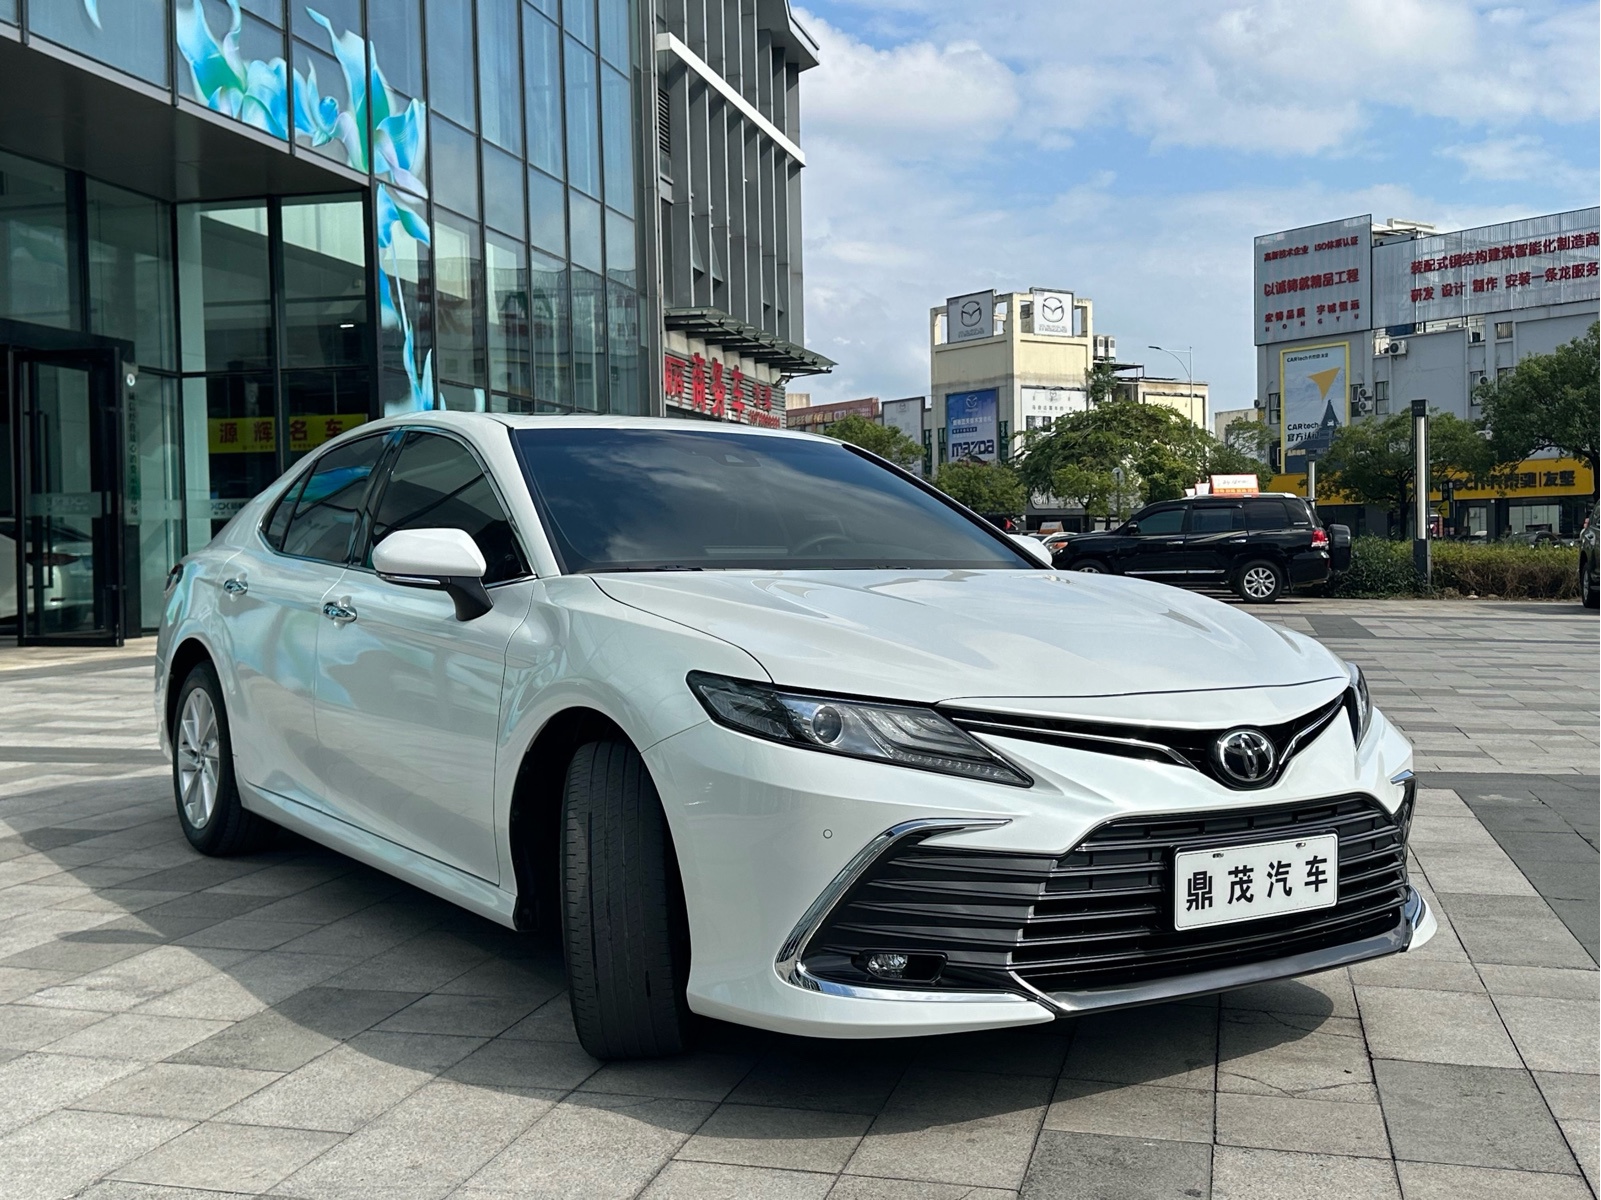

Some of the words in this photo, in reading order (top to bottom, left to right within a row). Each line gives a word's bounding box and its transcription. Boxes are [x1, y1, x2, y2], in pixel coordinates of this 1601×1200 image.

[1410, 231, 1600, 275] 装配式钢结构建筑智能化制造商
[1263, 268, 1360, 297] 以诚铸就精品工程
[1410, 286, 1435, 303] 研发
[1441, 281, 1466, 298] 设计
[1472, 276, 1498, 293] 制作
[1505, 261, 1600, 289] 安装一条龙服务
[219, 418, 343, 444] 源辉名车
[951, 439, 995, 457] mazda
[1186, 855, 1328, 912] 鼎茂汽车
